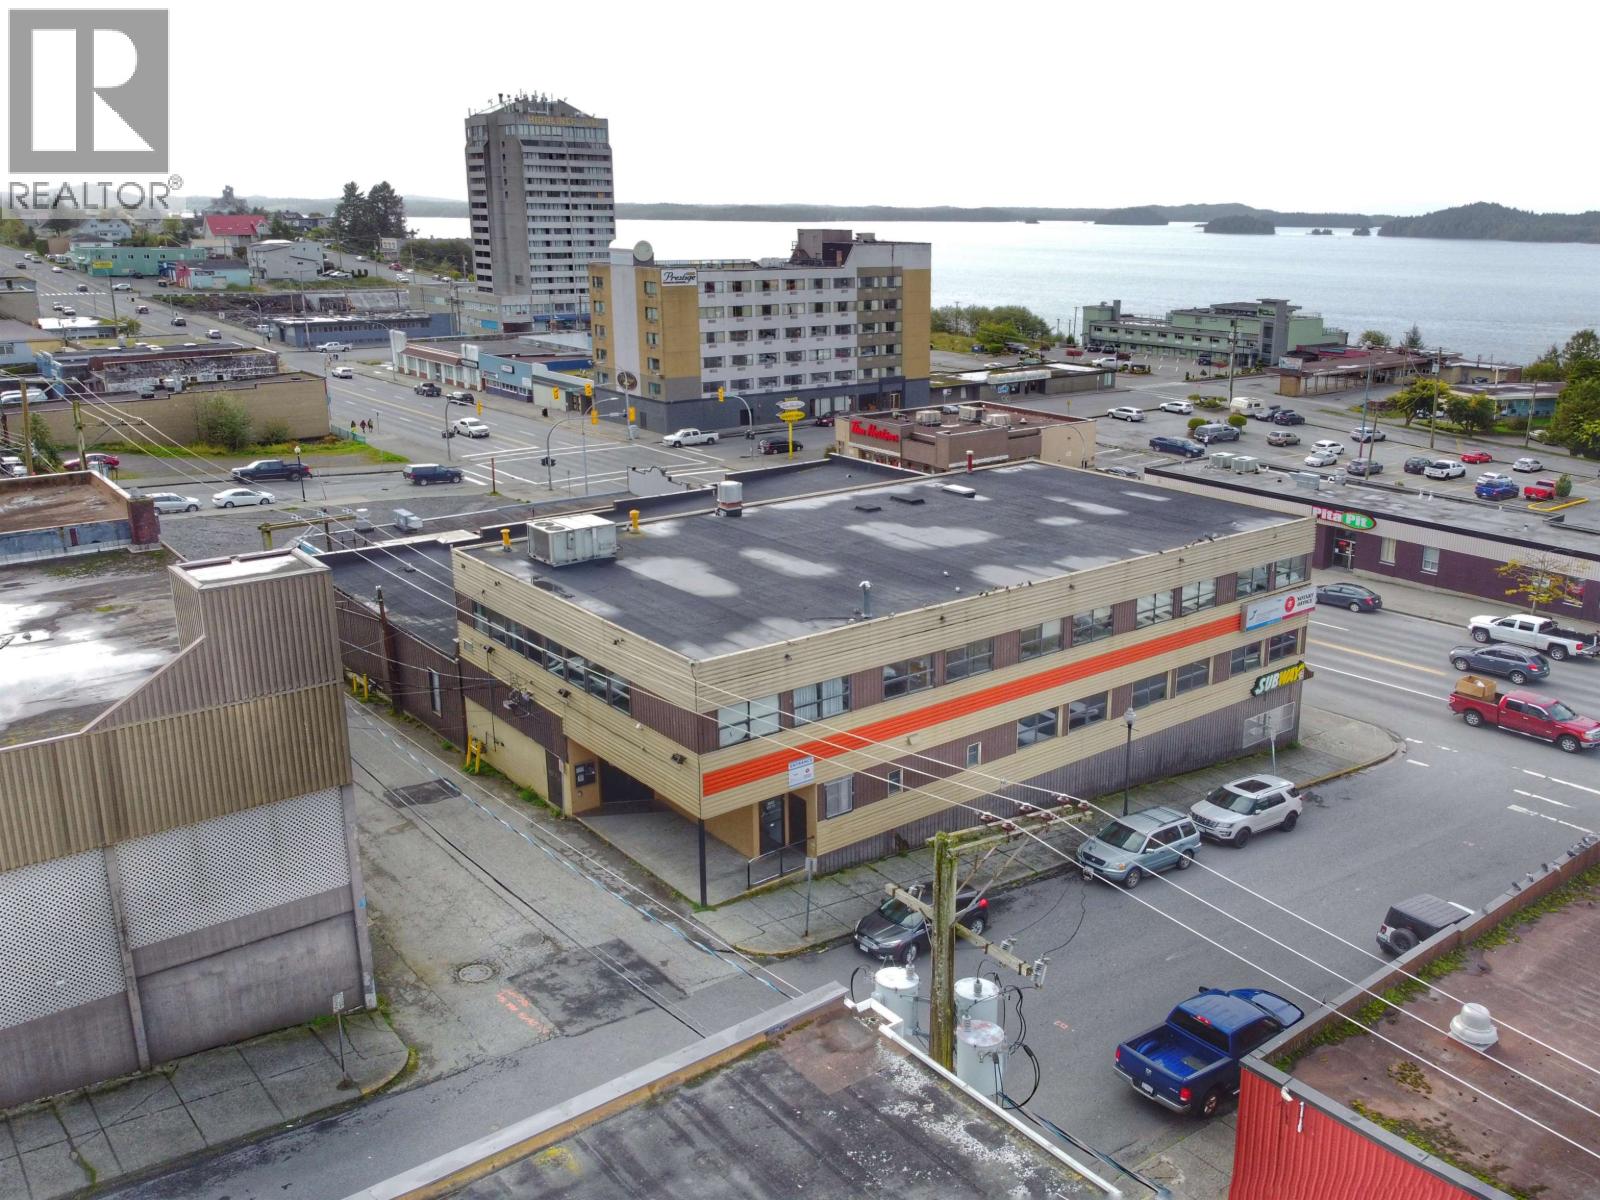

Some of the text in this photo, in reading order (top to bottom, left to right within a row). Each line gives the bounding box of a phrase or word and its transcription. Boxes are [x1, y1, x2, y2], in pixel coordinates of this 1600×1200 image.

[663, 271, 696, 283] Prestige
[851, 419, 900, 442] Tim Hortons
[1312, 505, 1368, 528] Pita Pit
[1255, 662, 1305, 695] SUBWAY
